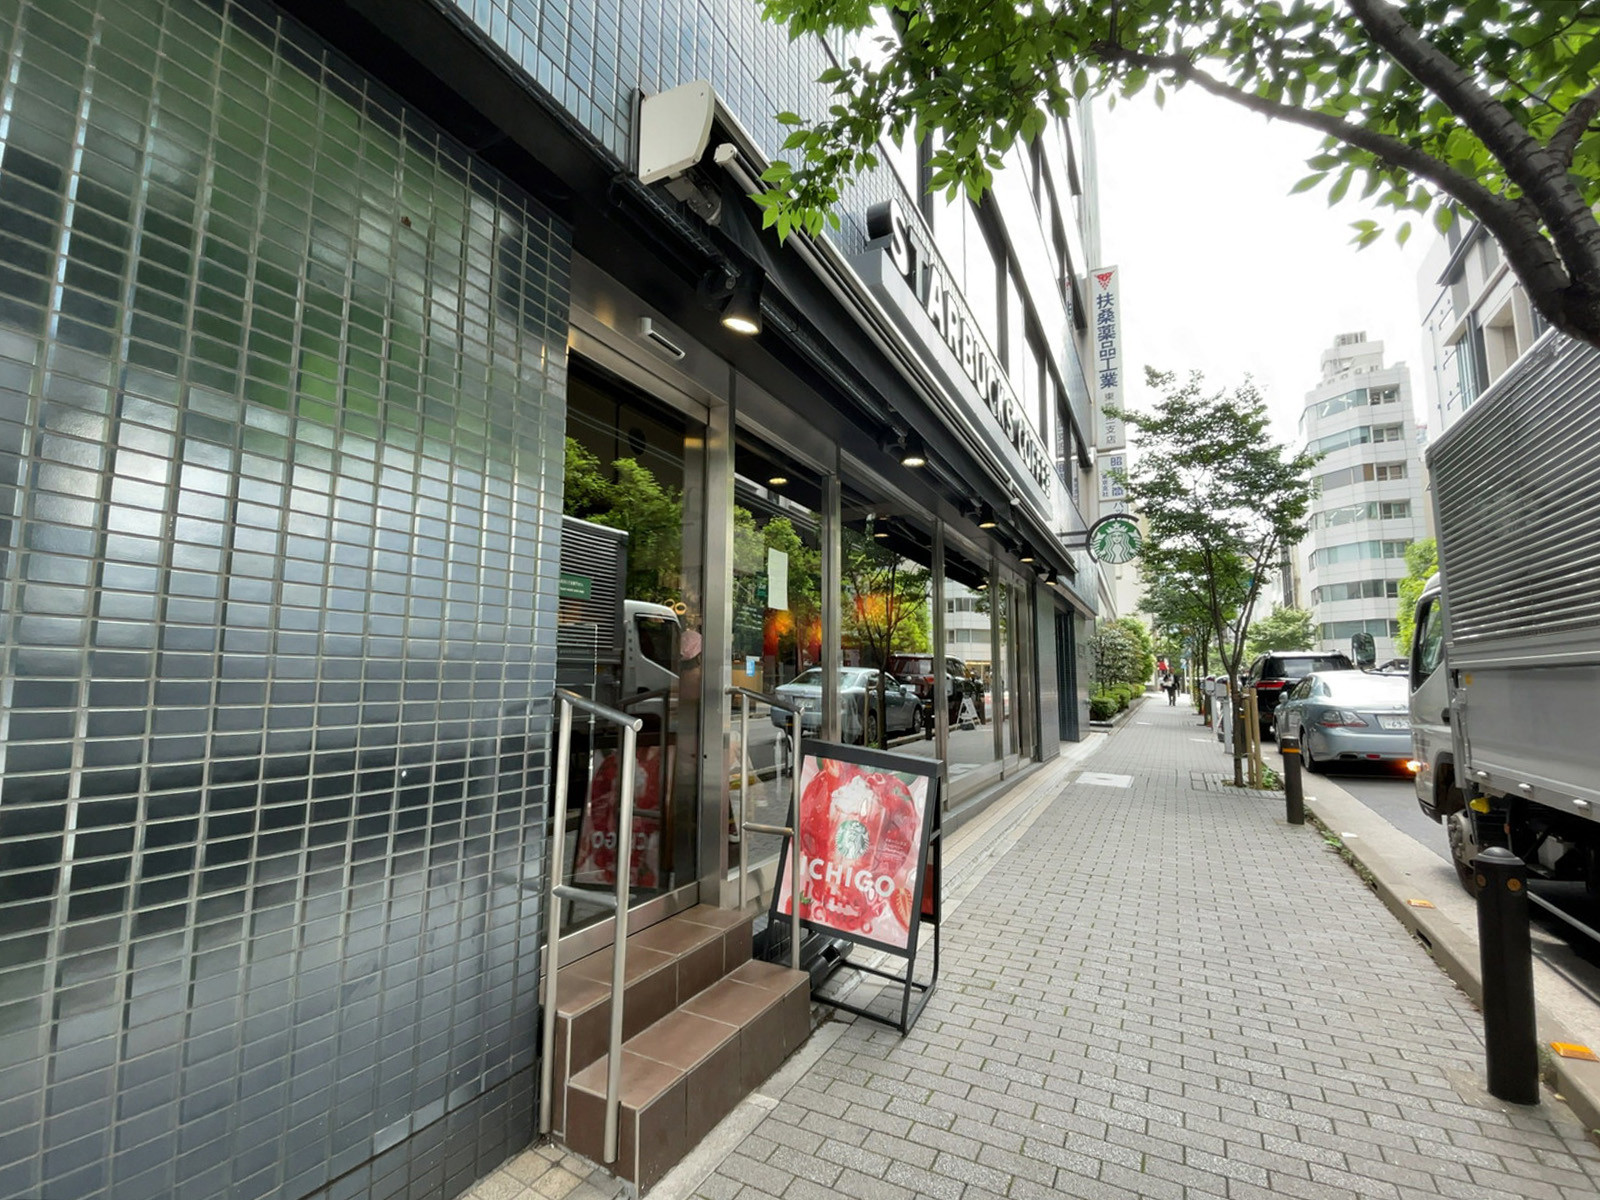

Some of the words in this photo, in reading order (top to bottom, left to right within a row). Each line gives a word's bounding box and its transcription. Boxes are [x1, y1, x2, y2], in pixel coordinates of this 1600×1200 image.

[884, 197, 1014, 443] STARBUCKS
[1096, 292, 1118, 390] 扶桑薬品工業
[800, 855, 895, 897] ICHIGO
